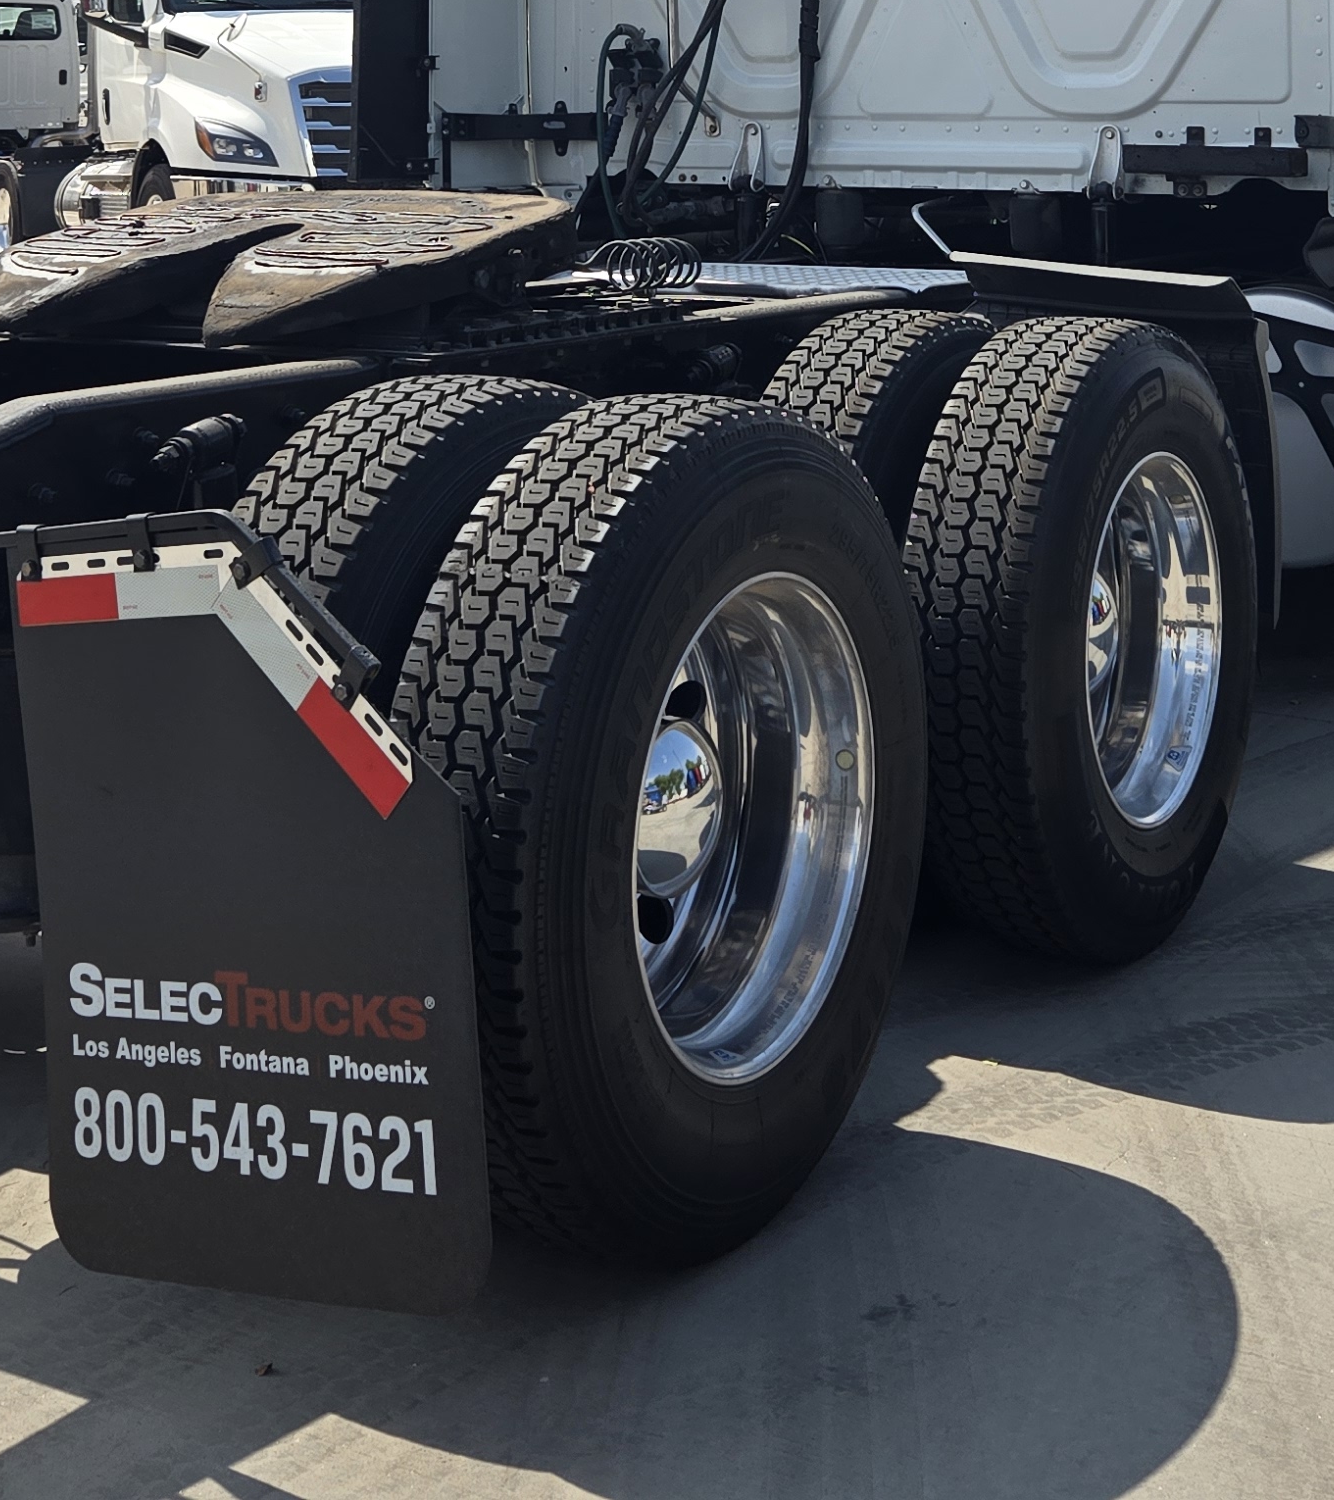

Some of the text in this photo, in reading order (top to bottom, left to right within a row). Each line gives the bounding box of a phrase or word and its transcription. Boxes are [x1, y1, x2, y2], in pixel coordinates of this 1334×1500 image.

[73, 1034, 429, 1085] Los Angeles Fontana Phoenix
[74, 1086, 437, 1195] 800-543-7621
